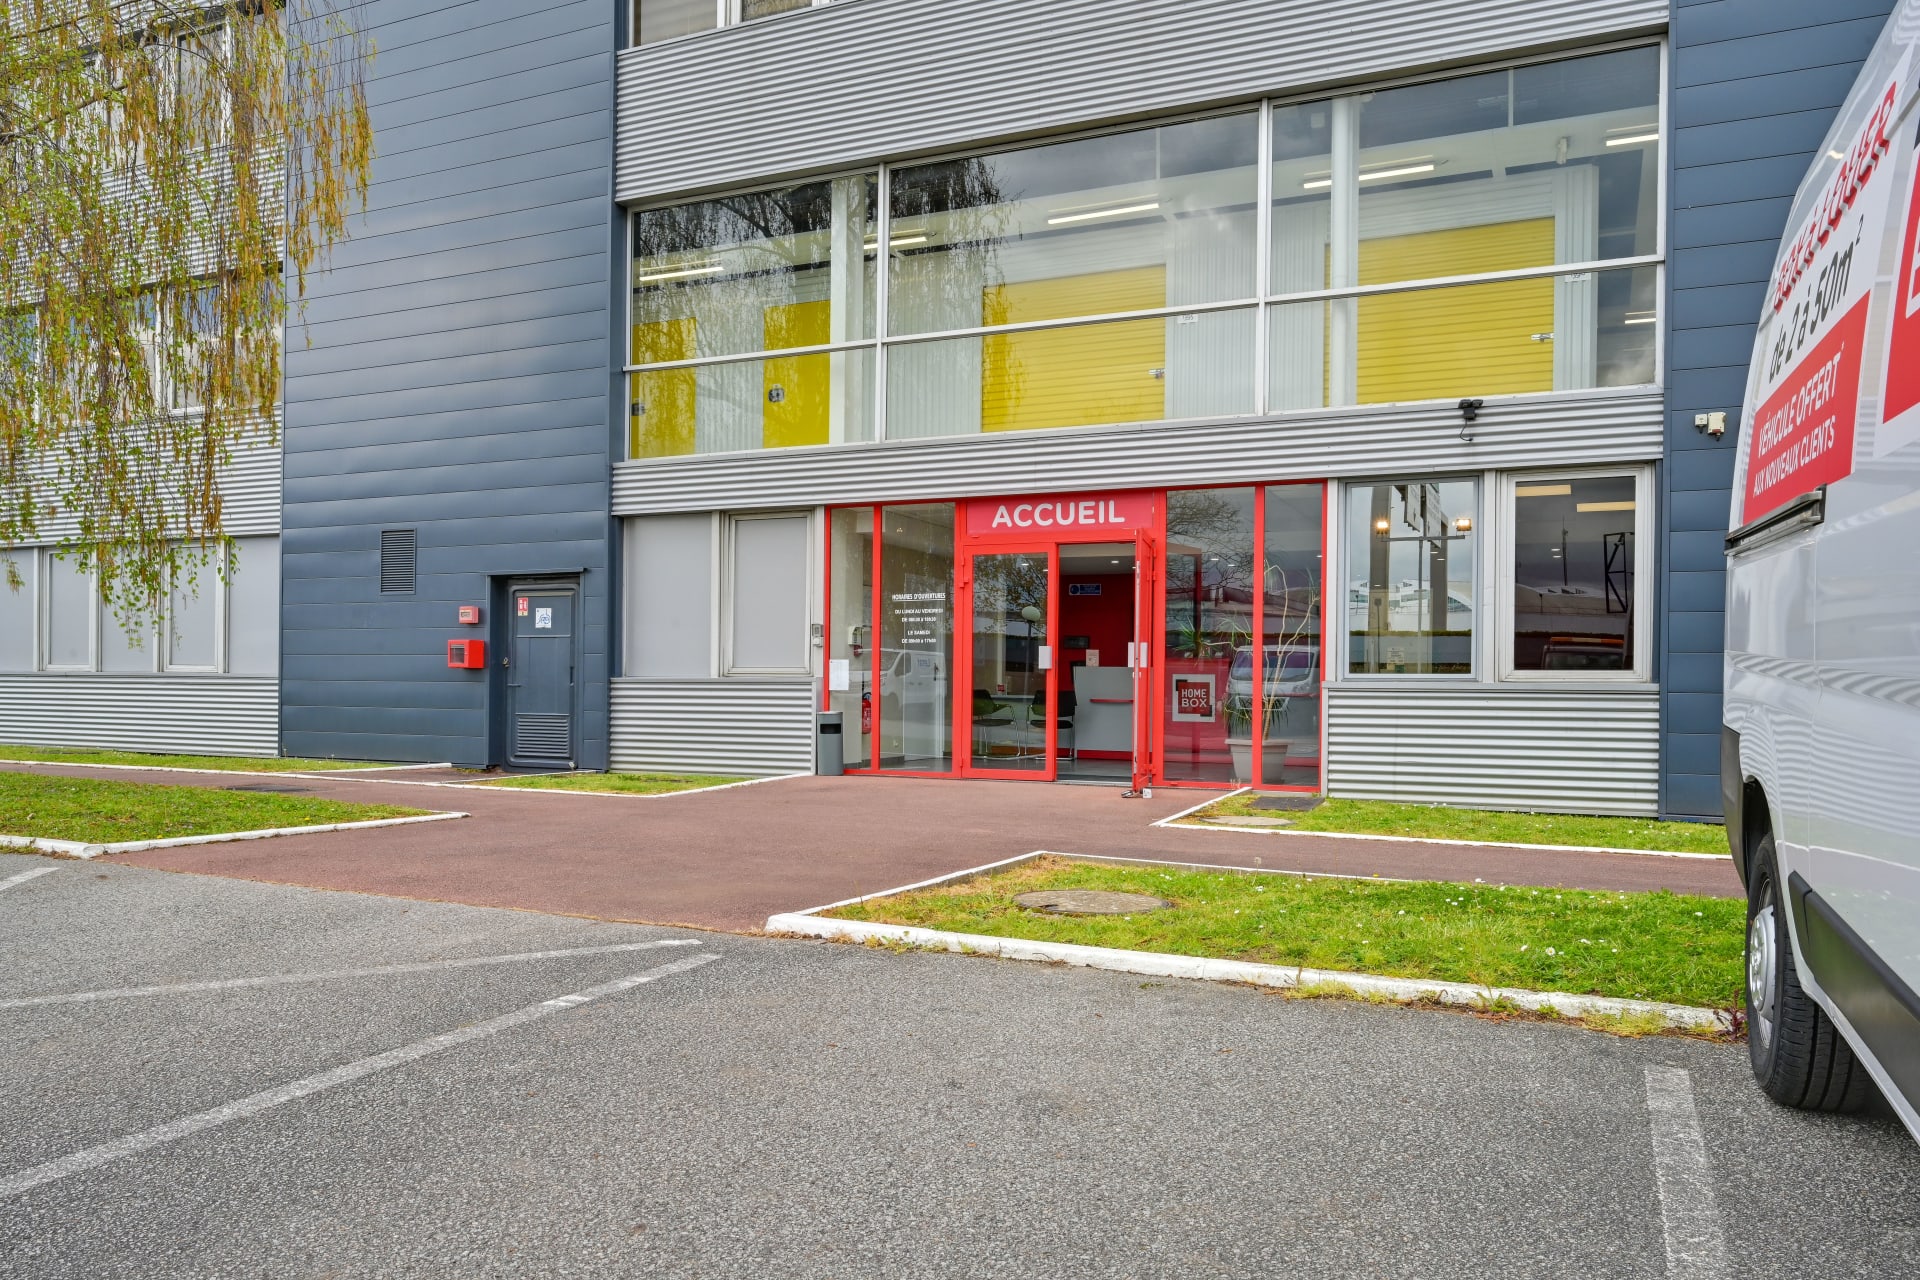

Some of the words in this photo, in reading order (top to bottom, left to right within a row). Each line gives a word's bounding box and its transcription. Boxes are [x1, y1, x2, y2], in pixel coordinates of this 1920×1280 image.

[1817, 80, 1897, 250] LOUER
[1769, 323, 1787, 384] de
[1785, 302, 1801, 364] 2
[1753, 467, 1766, 498] AUX
[1764, 441, 1801, 490] NOUVEAUX
[1800, 414, 1836, 468] CLIENTS
[1758, 393, 1797, 459] VÉHICULE
[991, 500, 1126, 528] ACCUEIL
[1181, 688, 1207, 698] HOME
[1181, 698, 1207, 708] BOX
